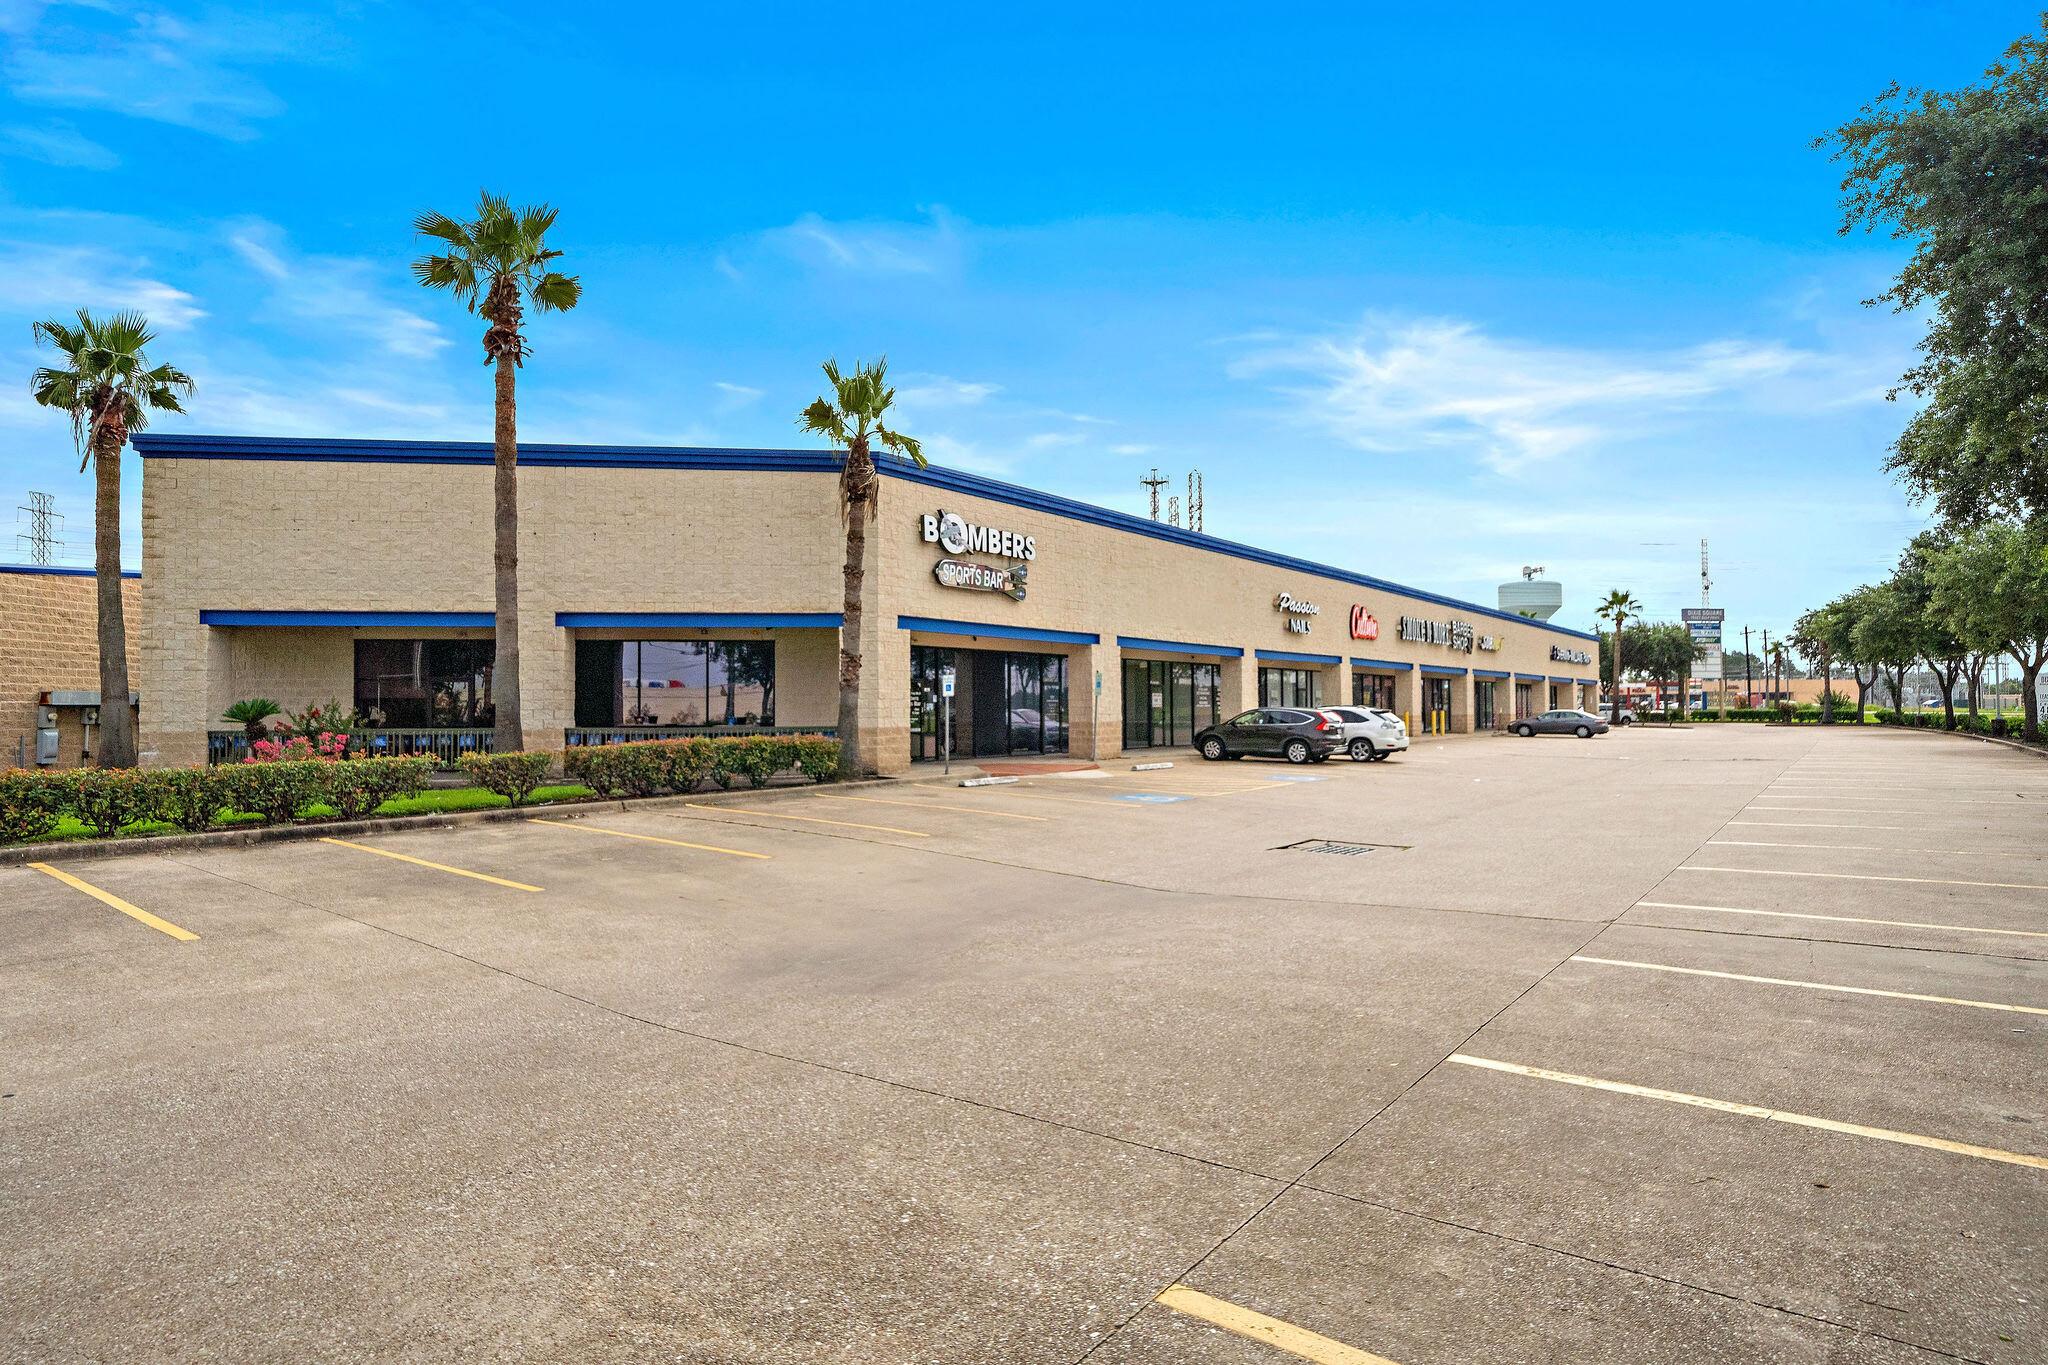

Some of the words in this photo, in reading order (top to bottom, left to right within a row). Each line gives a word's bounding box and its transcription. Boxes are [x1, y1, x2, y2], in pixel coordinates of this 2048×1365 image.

[922, 513, 1037, 561] BOMBERS
[942, 564, 982, 586] SPORTS
[984, 569, 1004, 589] BAR
[1278, 592, 1320, 615] Passion
[1290, 618, 1312, 634] NAILS
[1402, 616, 1426, 641] SMOKE
[1453, 635, 1468, 650] SHOP
